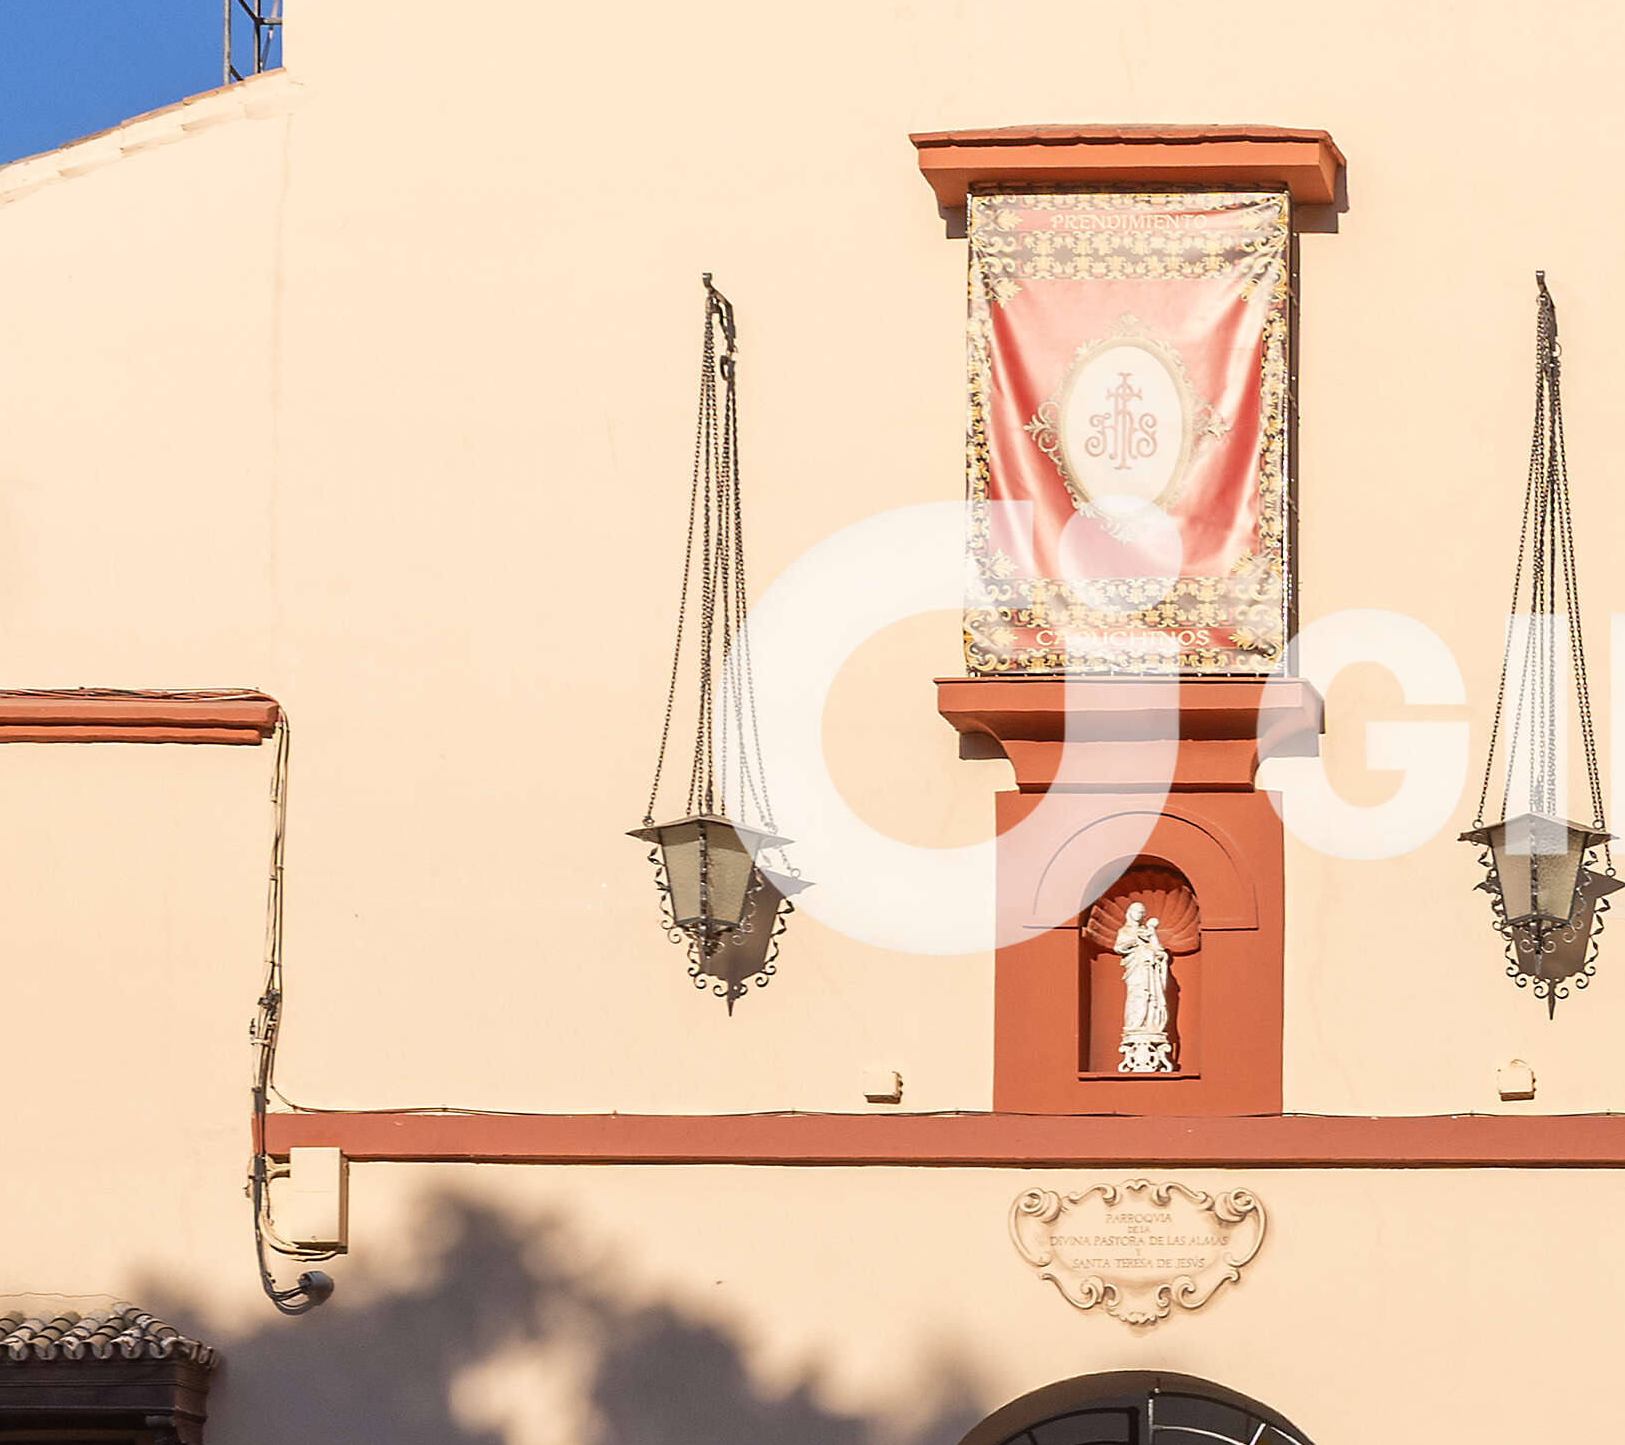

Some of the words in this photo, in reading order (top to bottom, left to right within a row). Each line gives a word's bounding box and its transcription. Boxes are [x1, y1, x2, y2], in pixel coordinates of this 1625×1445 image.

[1050, 214, 1208, 231] PRENDIMIENTO
[1035, 629, 1210, 647] CAPUCHINOS
[1050, 1236, 1092, 1247] DIVINA
[1094, 1235, 1144, 1246] PASTORA
[1149, 1235, 1164, 1246] DE
[1166, 1235, 1186, 1246] LAS
[1188, 1235, 1229, 1246] ALMAS
[1072, 1258, 1110, 1269] SANTA
[1115, 1258, 1154, 1269] TERESA
[1157, 1258, 1172, 1269] DE
